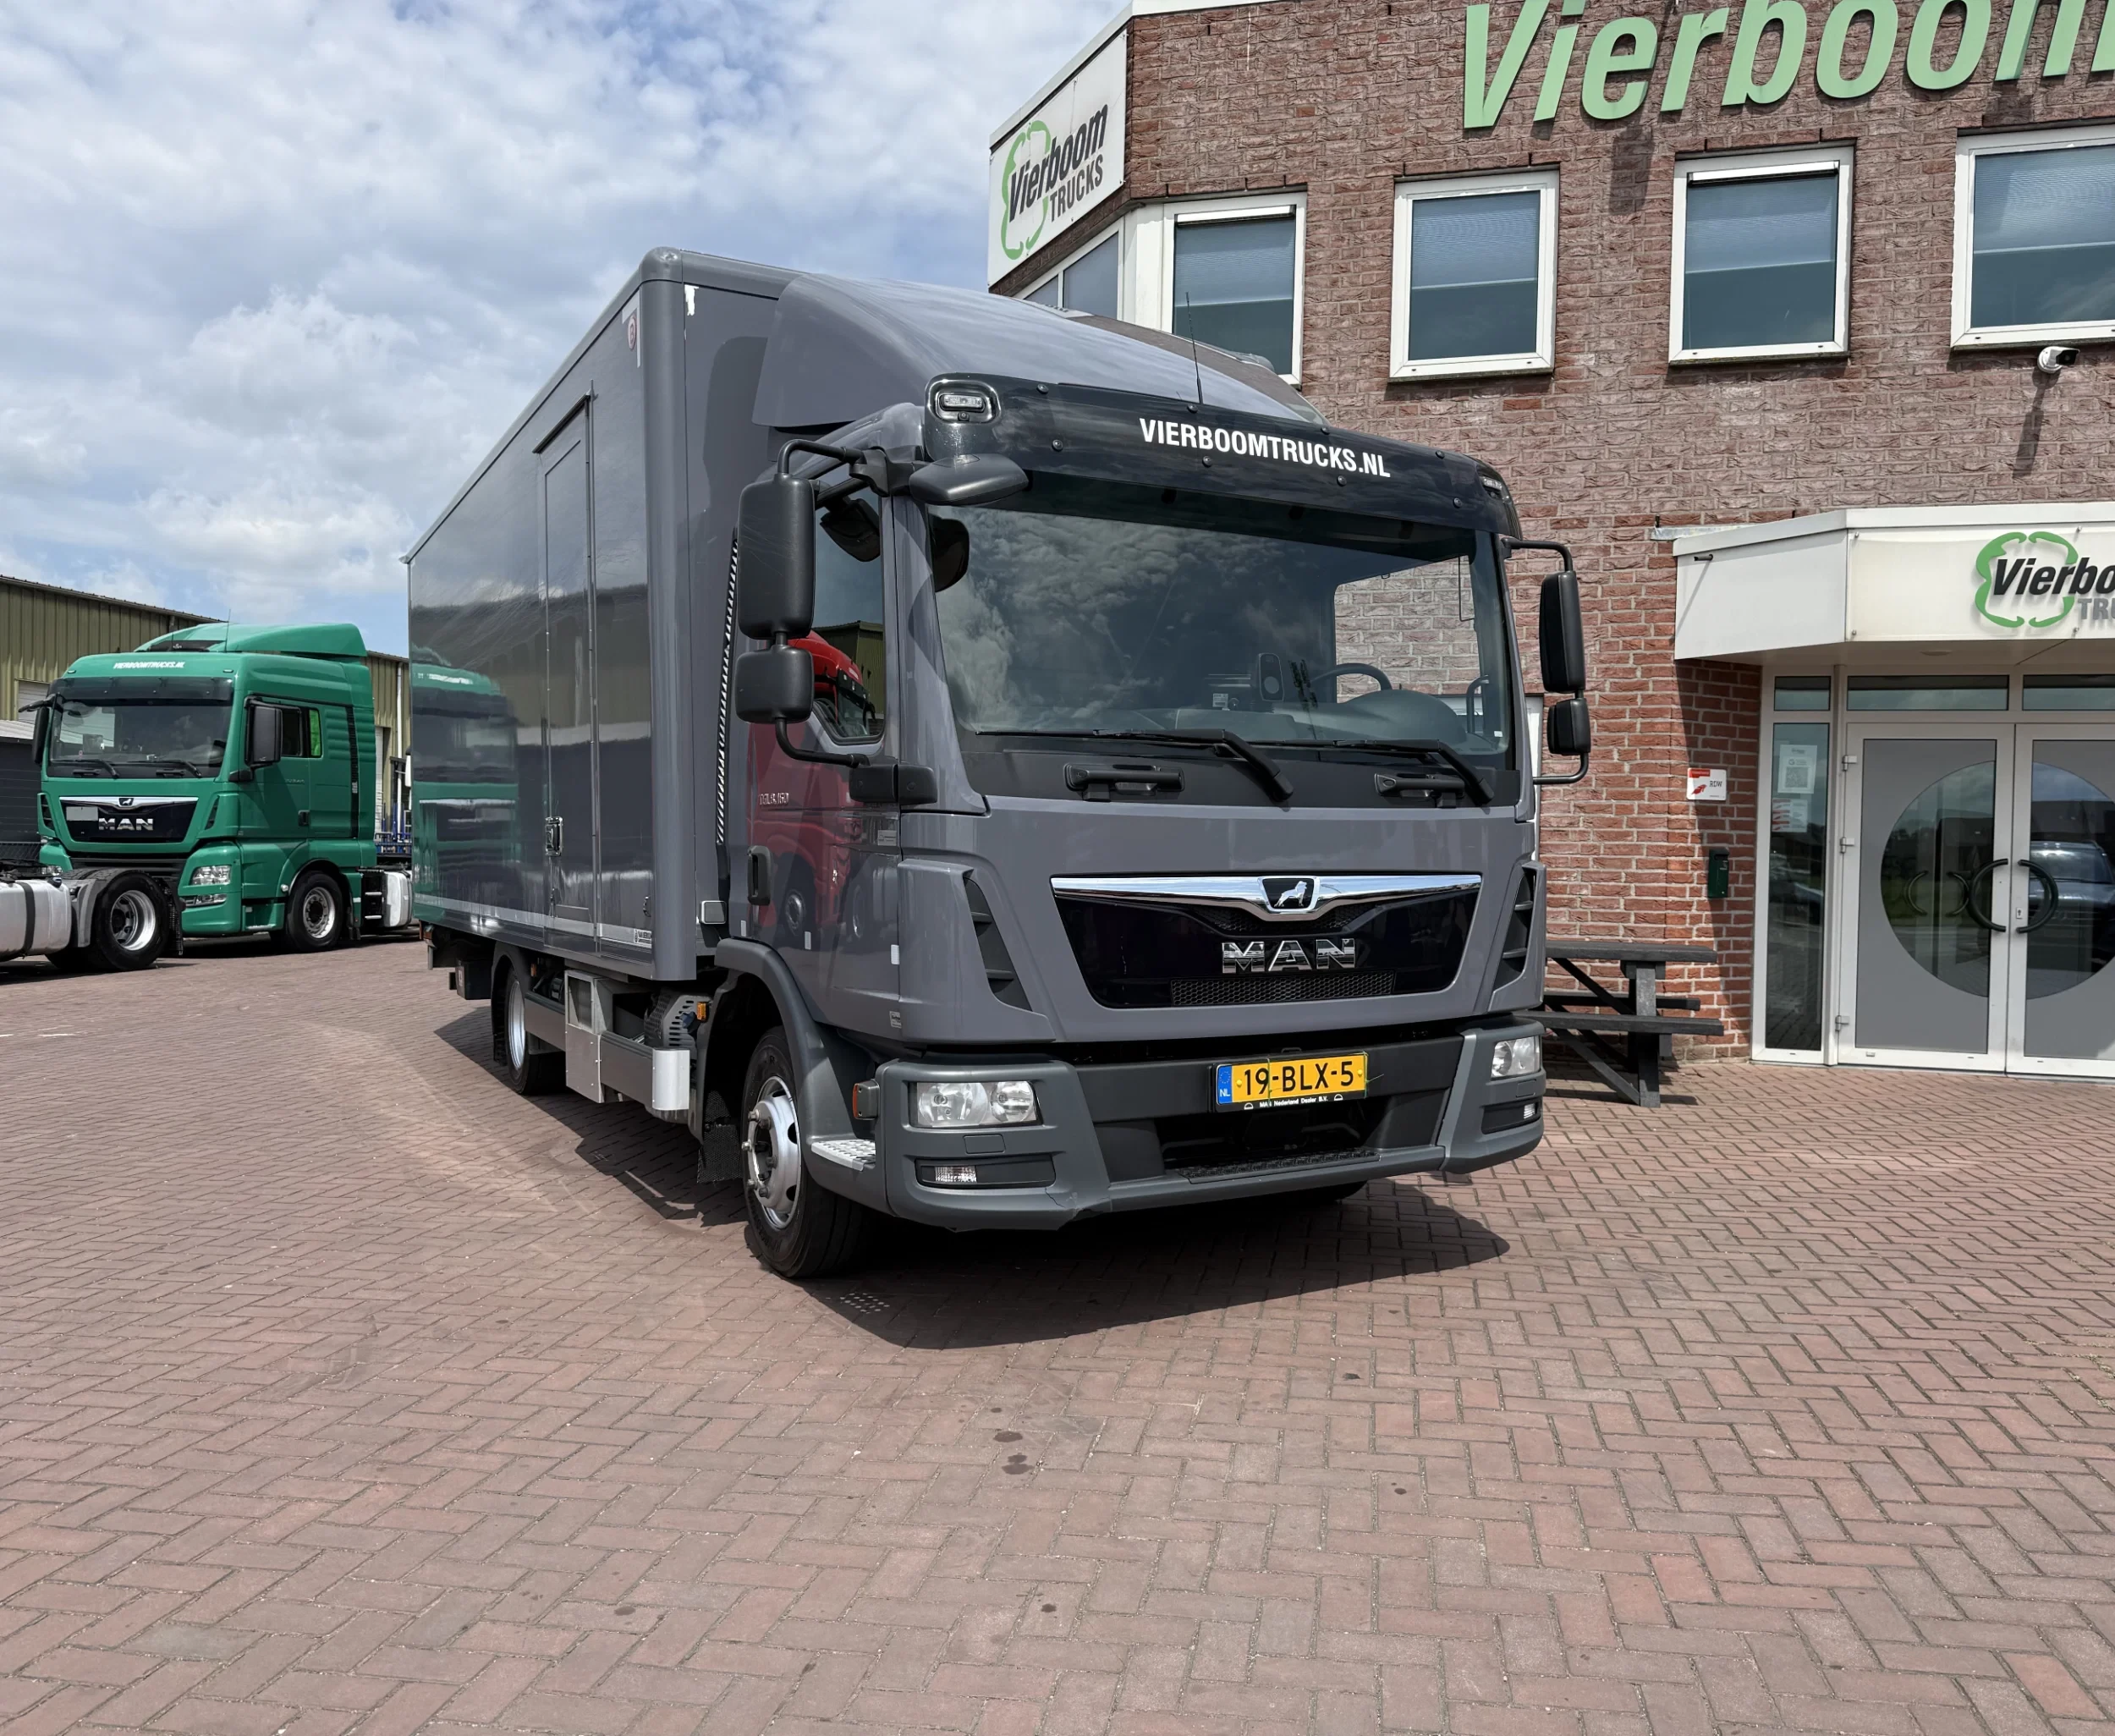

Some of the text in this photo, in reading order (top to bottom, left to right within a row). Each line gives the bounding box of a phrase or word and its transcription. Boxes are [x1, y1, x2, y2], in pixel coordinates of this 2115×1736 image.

[1464, 0, 2115, 129] Vierboom
[1009, 104, 1108, 223] Vierboom
[1050, 154, 1103, 222] TRUCKS
[1139, 418, 1391, 478] VIERBOOMTRUCKS.NL
[1993, 558, 2115, 596] Vierbo
[98, 818, 153, 831] MAN
[1222, 938, 1355, 974] MAN
[1219, 1088, 1231, 1097] NL
[1244, 1061, 1354, 1096] 19-BLX-5
[1273, 1098, 1299, 1107] Nederland
